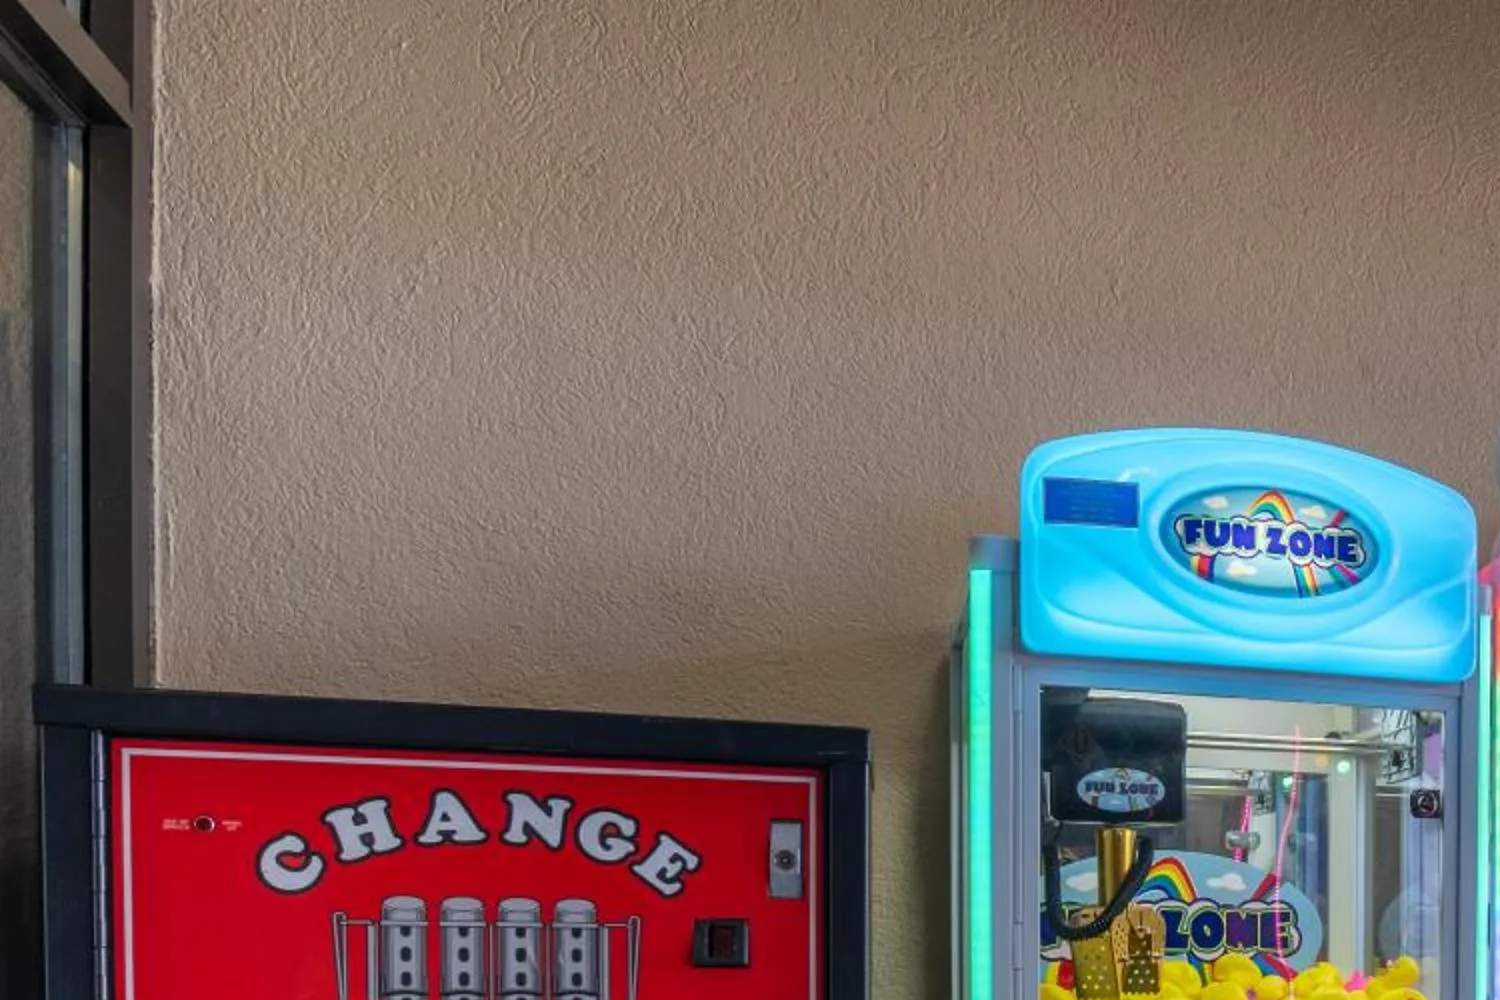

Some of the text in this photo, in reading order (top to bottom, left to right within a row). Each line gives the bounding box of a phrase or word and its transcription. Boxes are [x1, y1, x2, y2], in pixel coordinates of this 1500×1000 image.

[1184, 519, 1360, 564] FUN ZONE
[257, 788, 703, 898] CHANGE
[1157, 905, 1292, 949] ZONE
